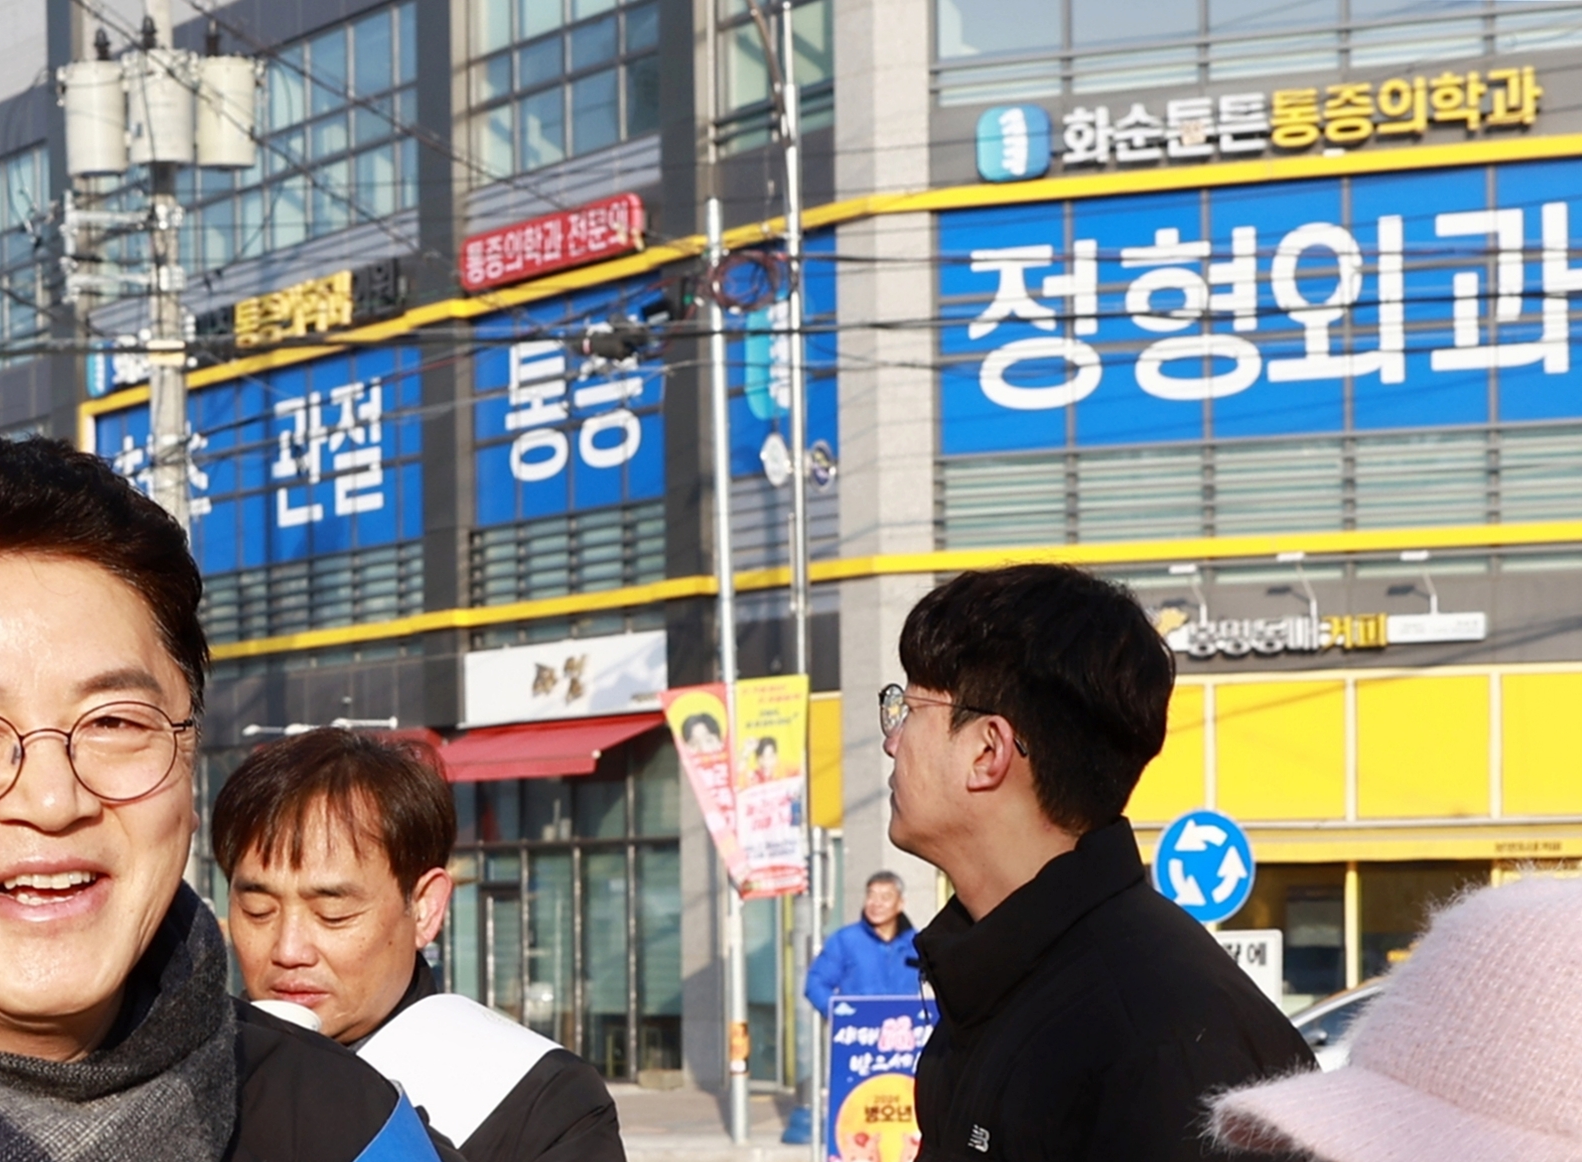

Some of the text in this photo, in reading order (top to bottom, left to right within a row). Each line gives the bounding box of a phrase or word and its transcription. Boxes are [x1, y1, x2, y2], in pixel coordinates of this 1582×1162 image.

[466, 201, 630, 284] 통증의학과 전문의
[967, 202, 1582, 411] 정형외과
[271, 378, 385, 528] 관절
[503, 340, 644, 483] 통증
[864, 1105, 913, 1123] 병오년
